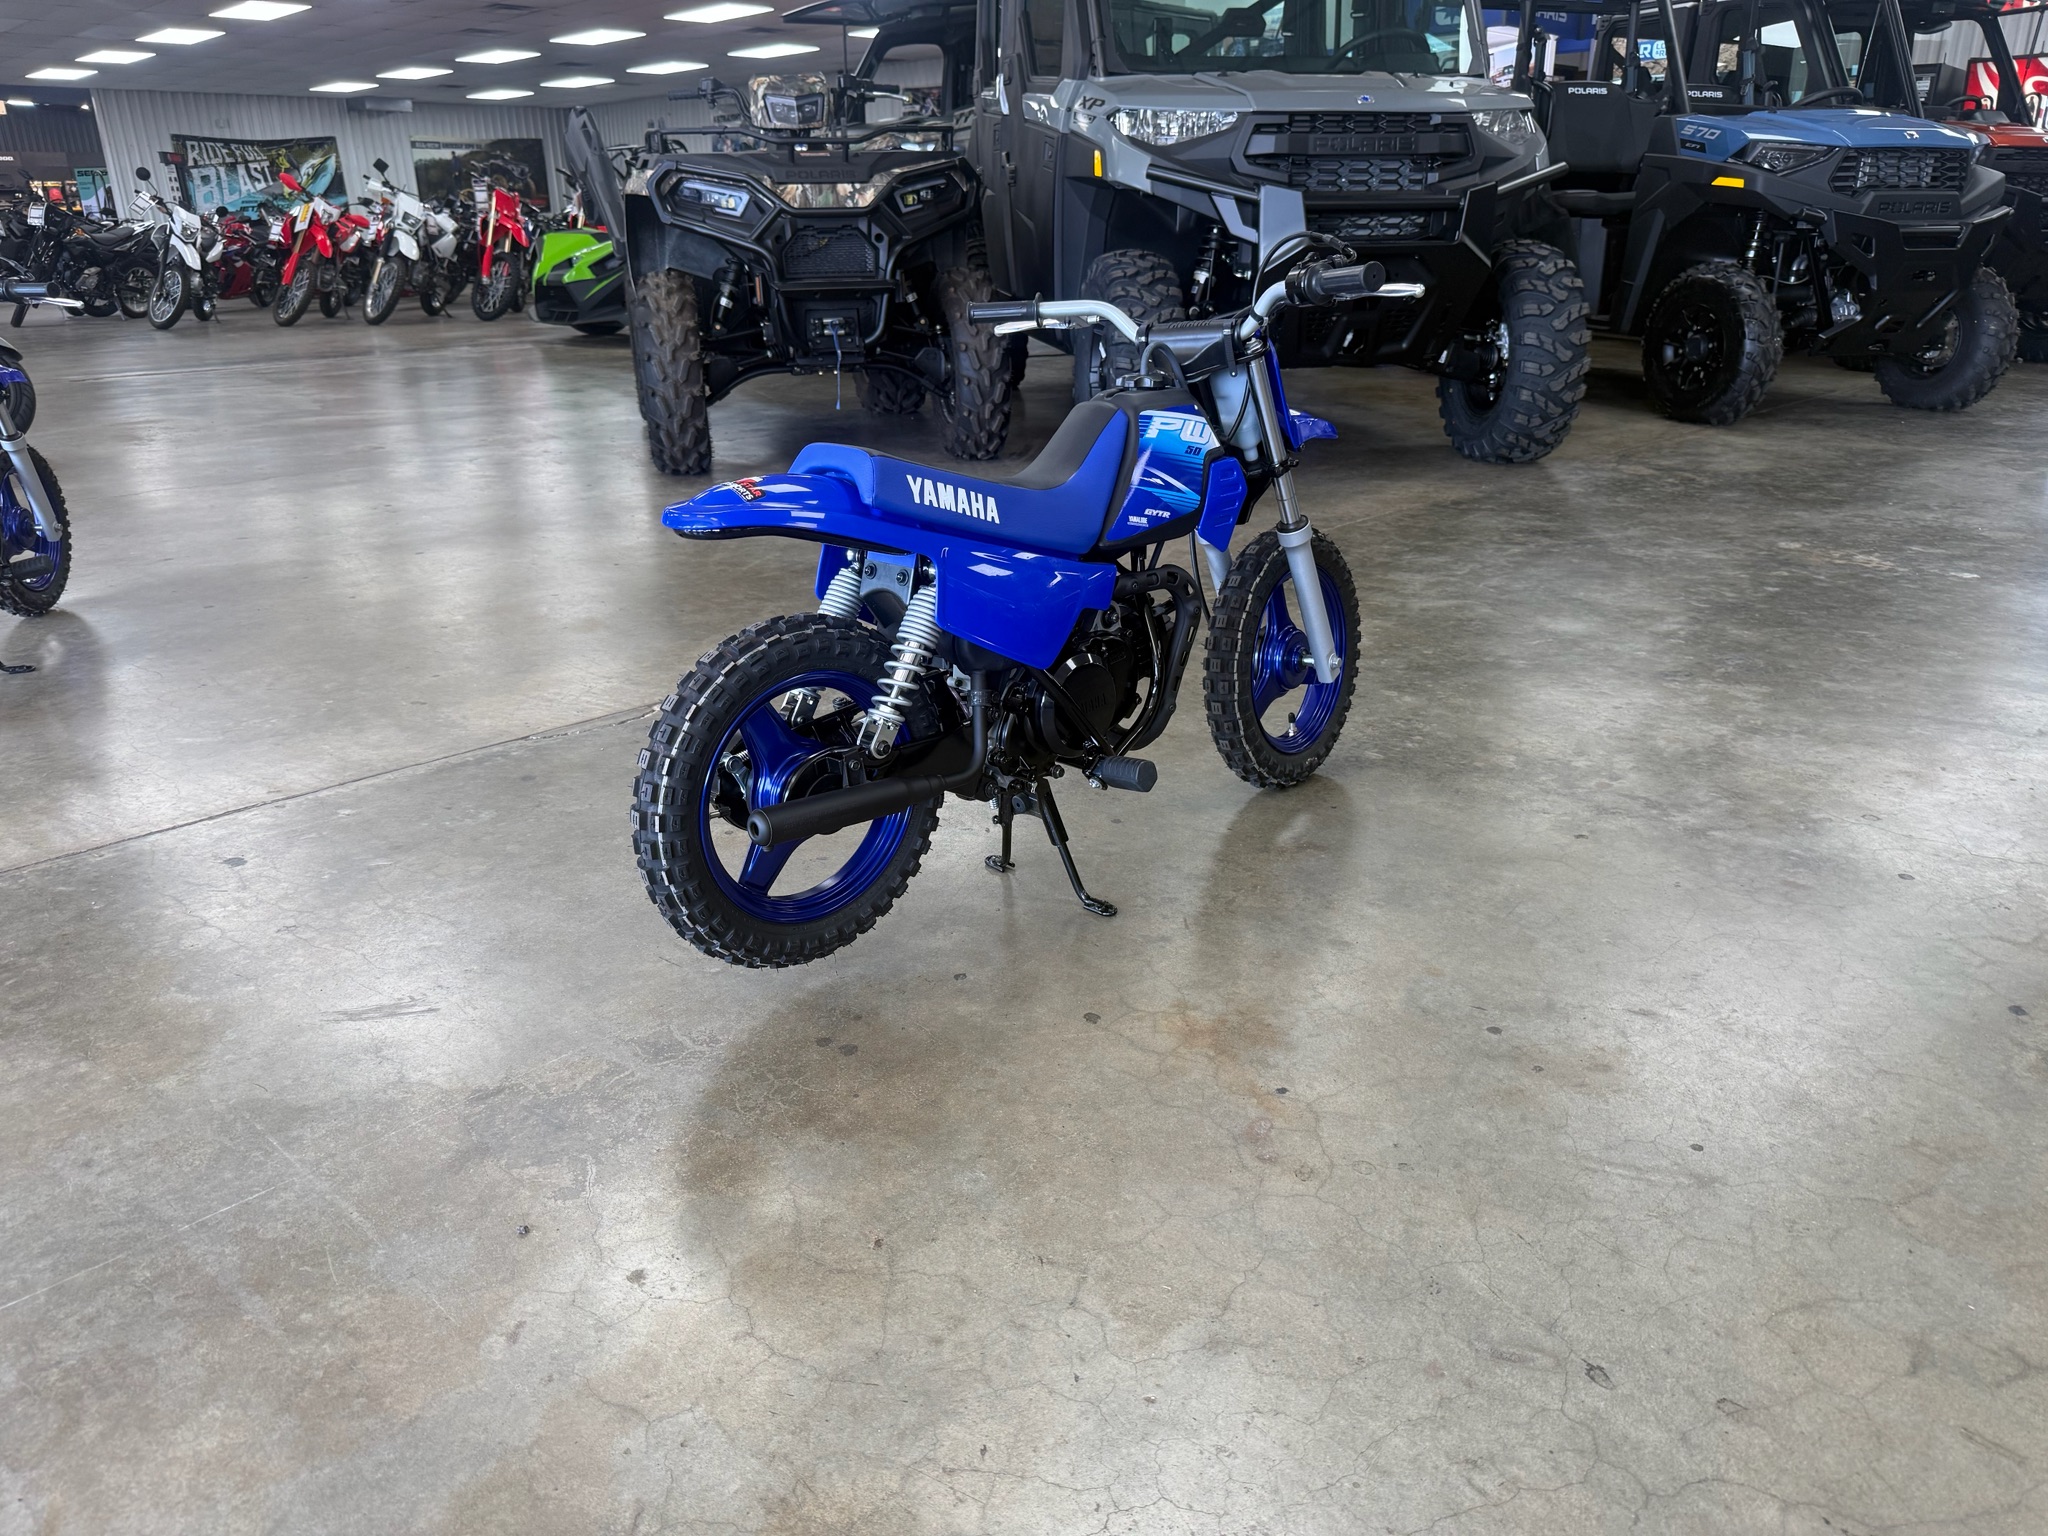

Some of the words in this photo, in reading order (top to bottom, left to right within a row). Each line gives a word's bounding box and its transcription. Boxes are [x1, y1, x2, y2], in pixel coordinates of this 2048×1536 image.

[1567, 86, 1608, 95] POLARIS
[1078, 95, 1106, 110] XP
[1680, 124, 1722, 140] 570
[1313, 135, 1416, 152] POLARIS
[185, 140, 234, 166] RIDE
[229, 143, 268, 164] FULL
[785, 169, 857, 179] POLARIS
[190, 160, 274, 212] BLAST
[1877, 201, 1952, 214] POLARIS
[1145, 415, 1211, 445] PW
[1184, 445, 1203, 456] 50
[906, 474, 1000, 524] YAMAHA
[1144, 507, 1171, 519] GYTR
